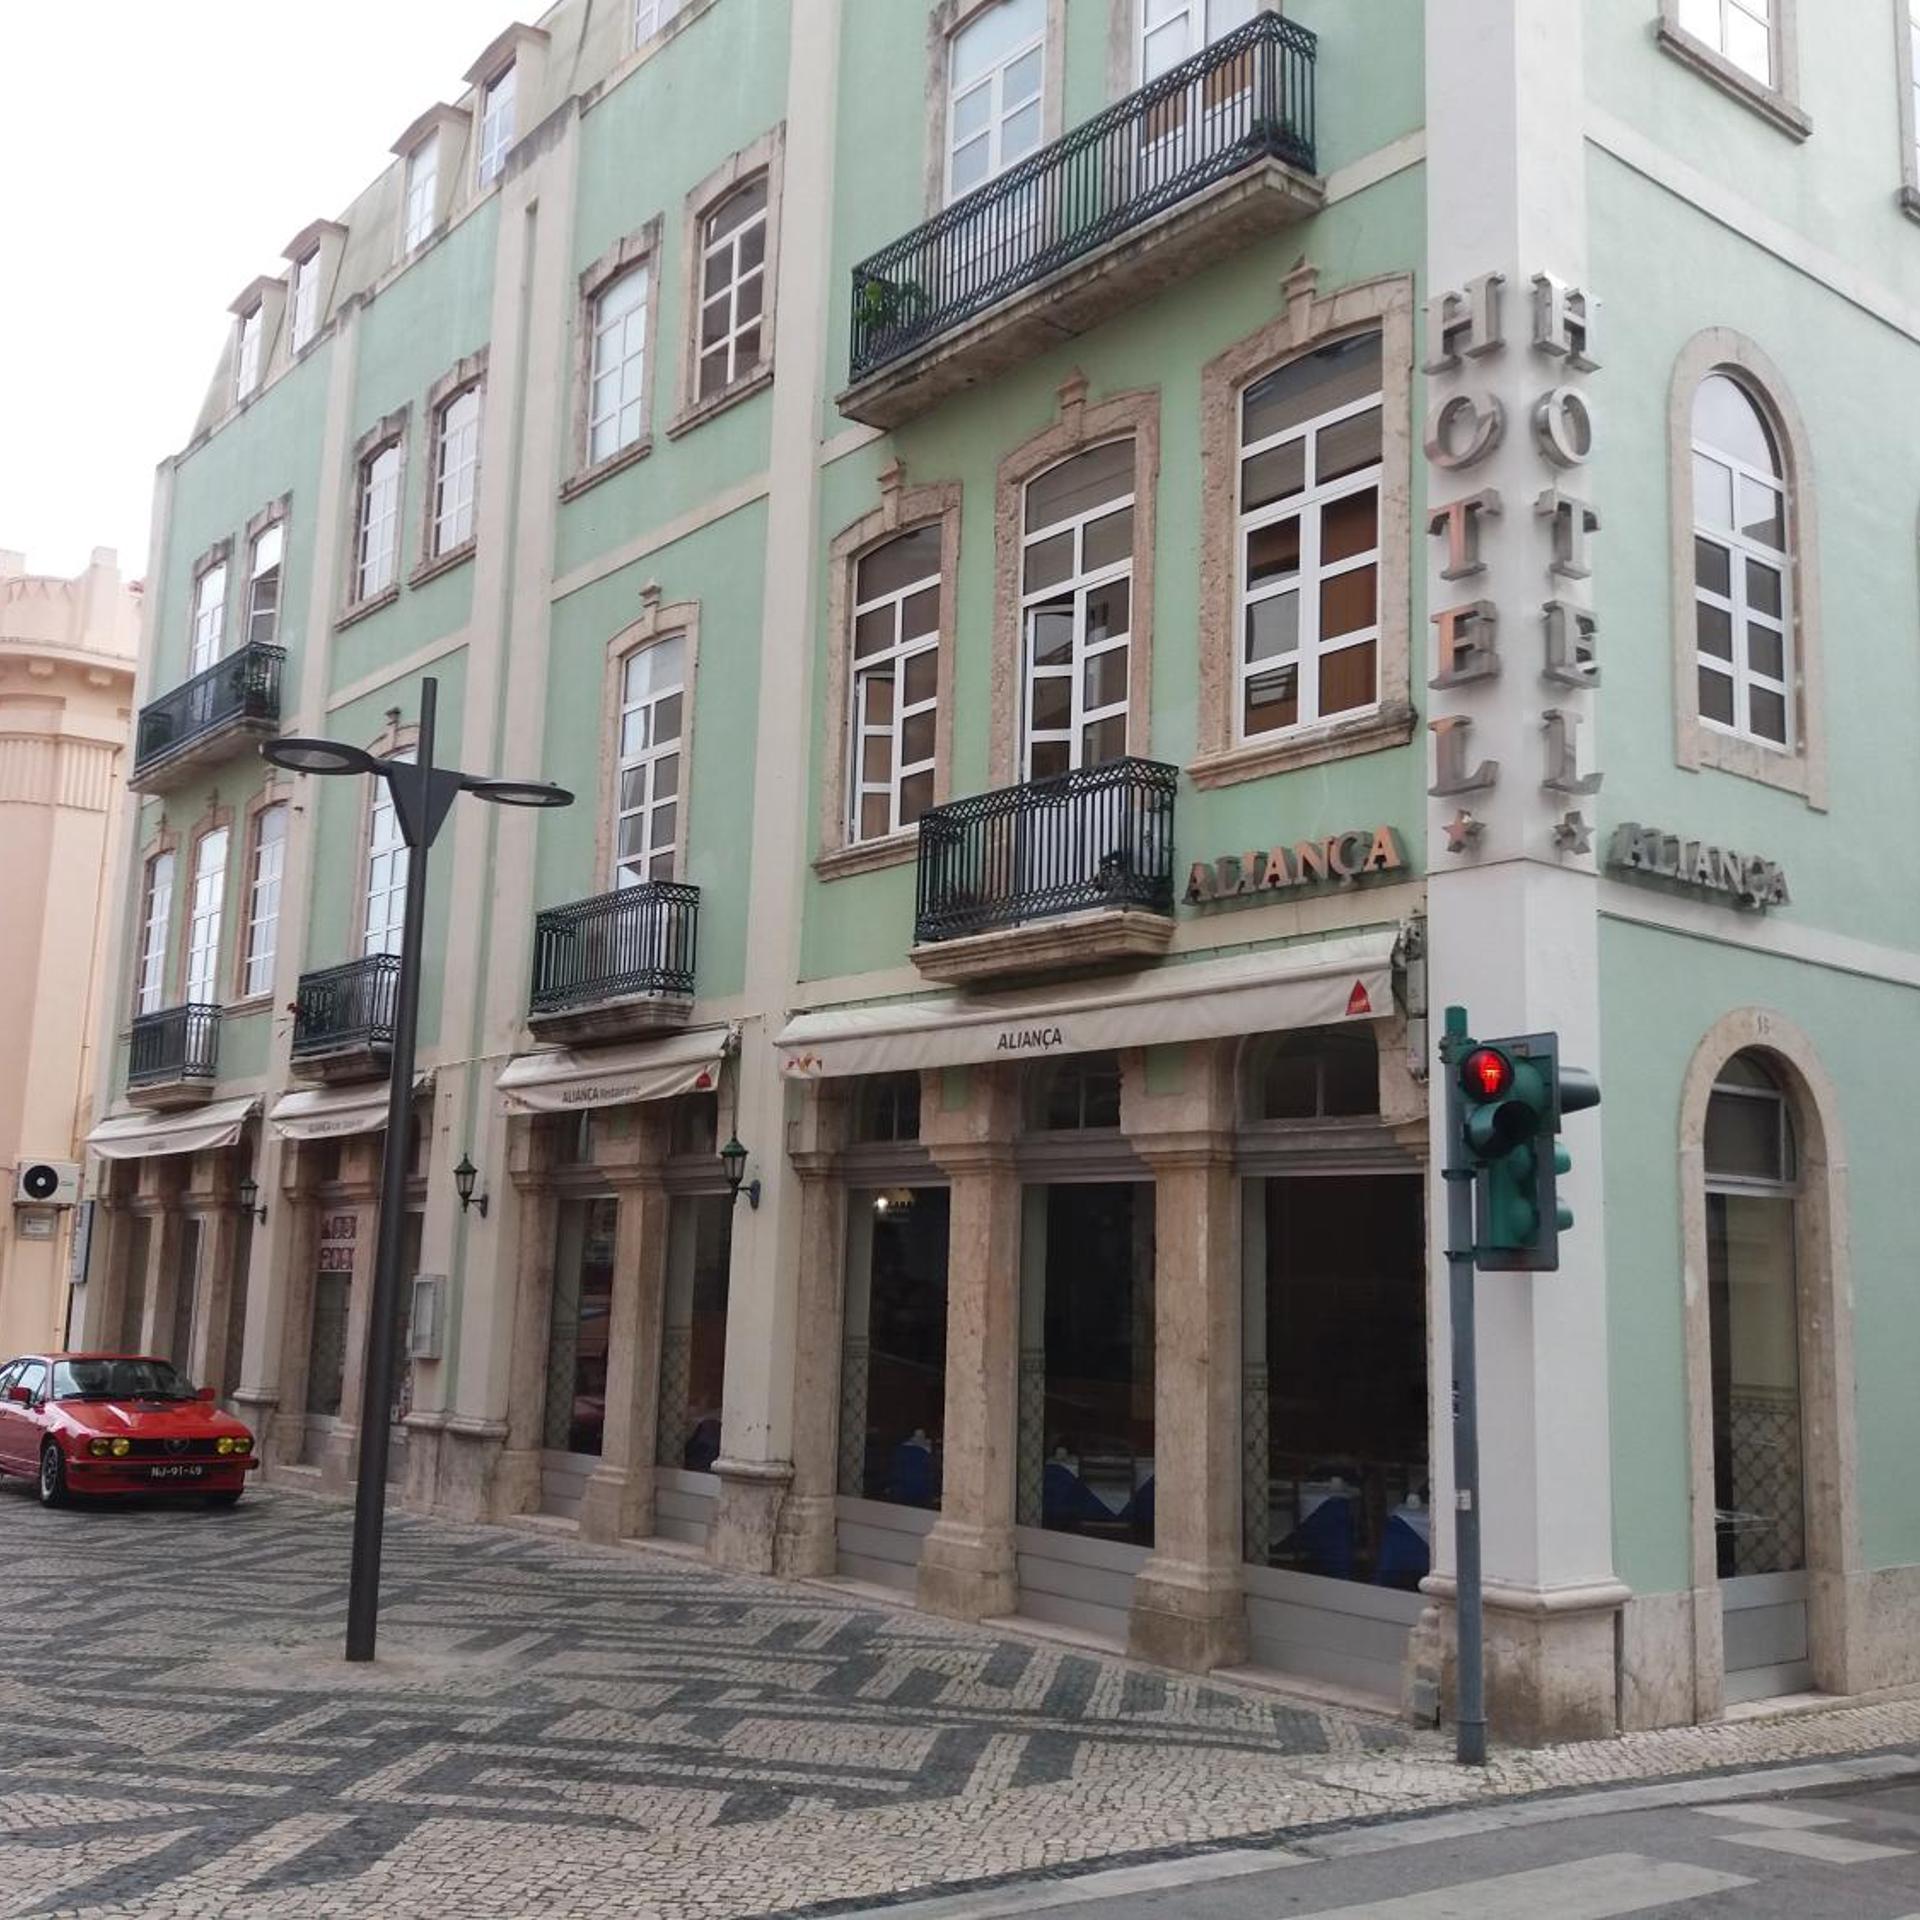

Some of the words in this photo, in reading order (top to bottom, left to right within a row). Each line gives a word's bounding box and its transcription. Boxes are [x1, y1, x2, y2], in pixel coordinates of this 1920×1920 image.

[1422, 270, 1507, 795] HOTEL
[1530, 269, 1604, 795] HOTEL
[1182, 825, 1404, 905] ALIANÇA
[1607, 822, 1792, 910] ALIANÇA
[996, 1027, 1063, 1051] ALIANÇA
